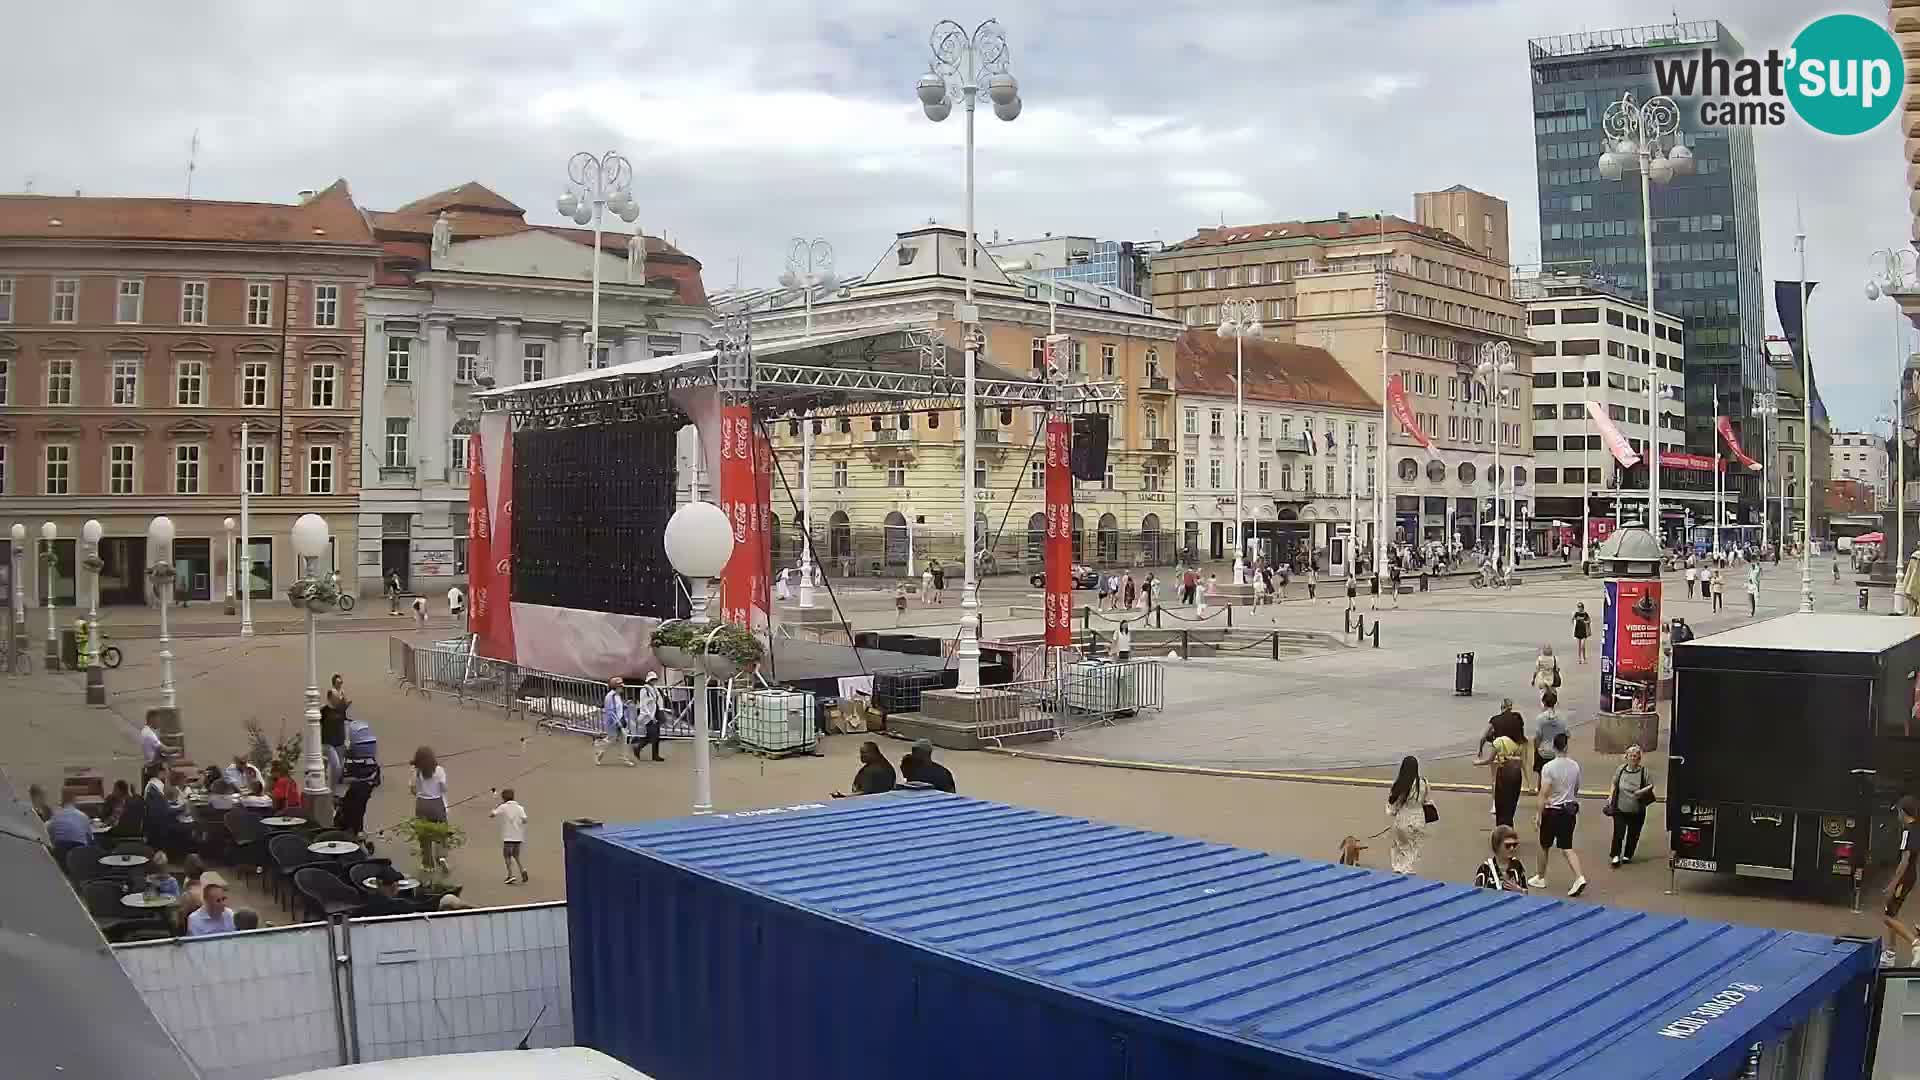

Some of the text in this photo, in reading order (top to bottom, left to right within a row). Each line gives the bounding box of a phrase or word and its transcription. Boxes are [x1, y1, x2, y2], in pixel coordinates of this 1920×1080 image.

[721, 416, 732, 460] Coca-Cola
[735, 416, 748, 460] Coca-Cola
[1047, 432, 1057, 467] Coca-Cola
[734, 502, 747, 543] Coca-Cola
[1047, 503, 1057, 538] Coca-Cola
[1060, 503, 1069, 538] Coca-Cola
[1047, 592, 1056, 628] Coca-Cola
[1060, 592, 1069, 628] Coca-Cola
[1690, 990, 1747, 1019] 300629
